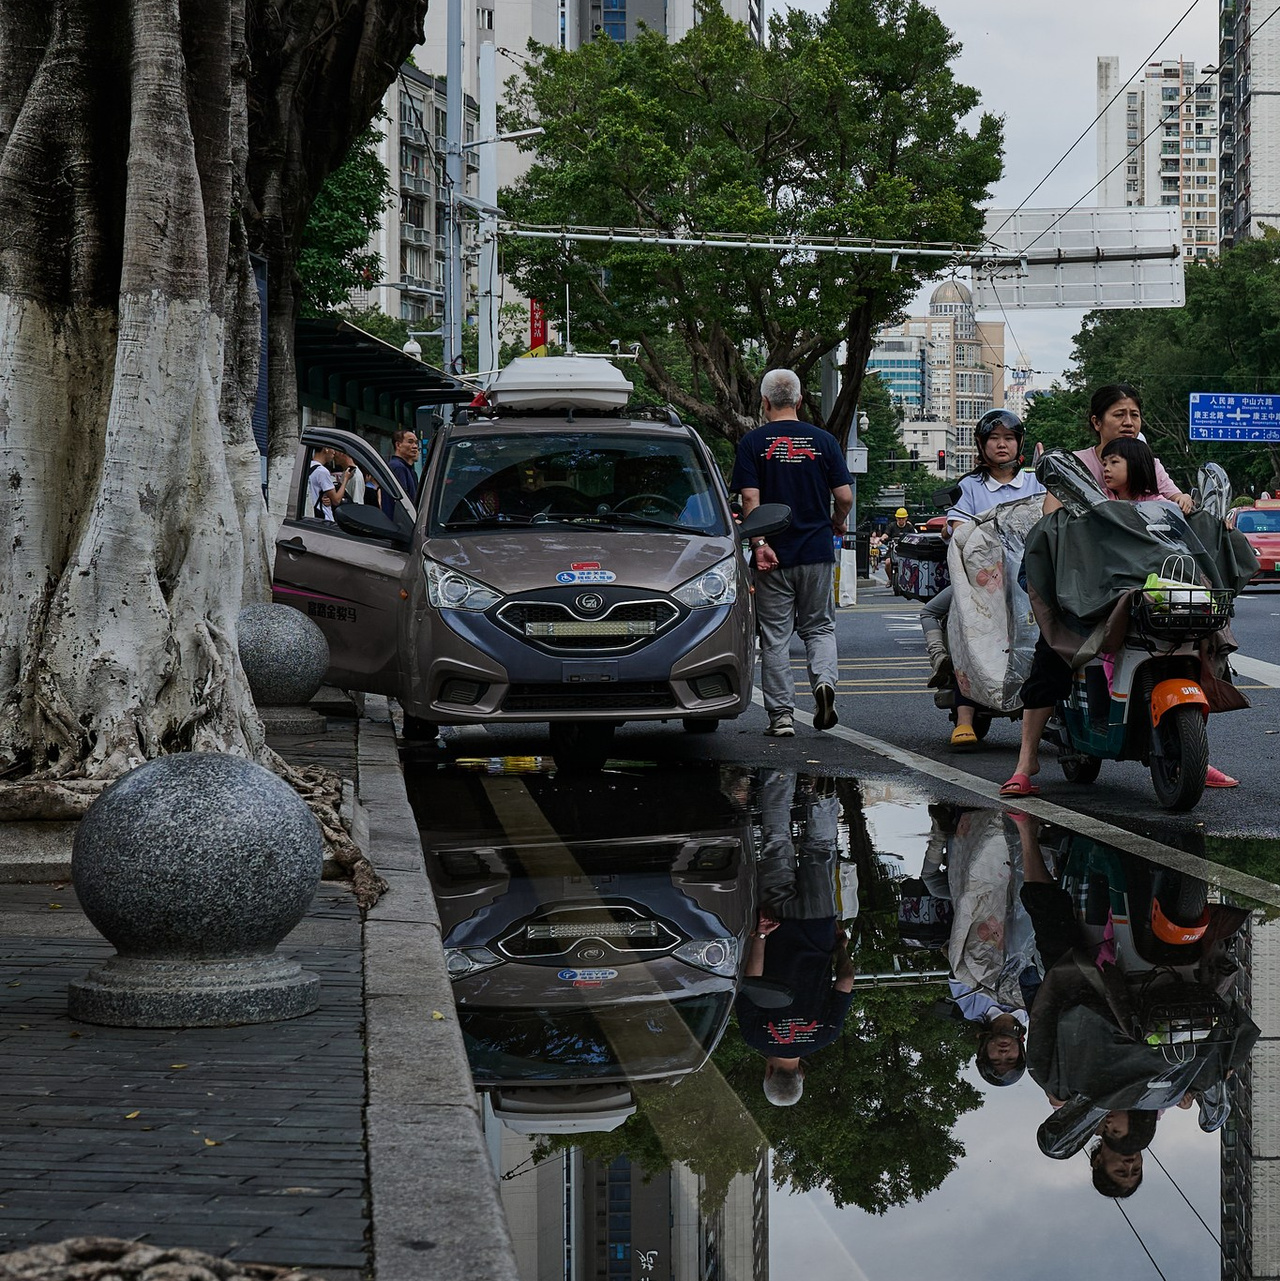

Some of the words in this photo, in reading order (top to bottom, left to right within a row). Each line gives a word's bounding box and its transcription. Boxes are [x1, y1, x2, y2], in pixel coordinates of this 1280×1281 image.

[1210, 396, 1235, 405] 人民路
[1242, 397, 1273, 406] 中山六路
